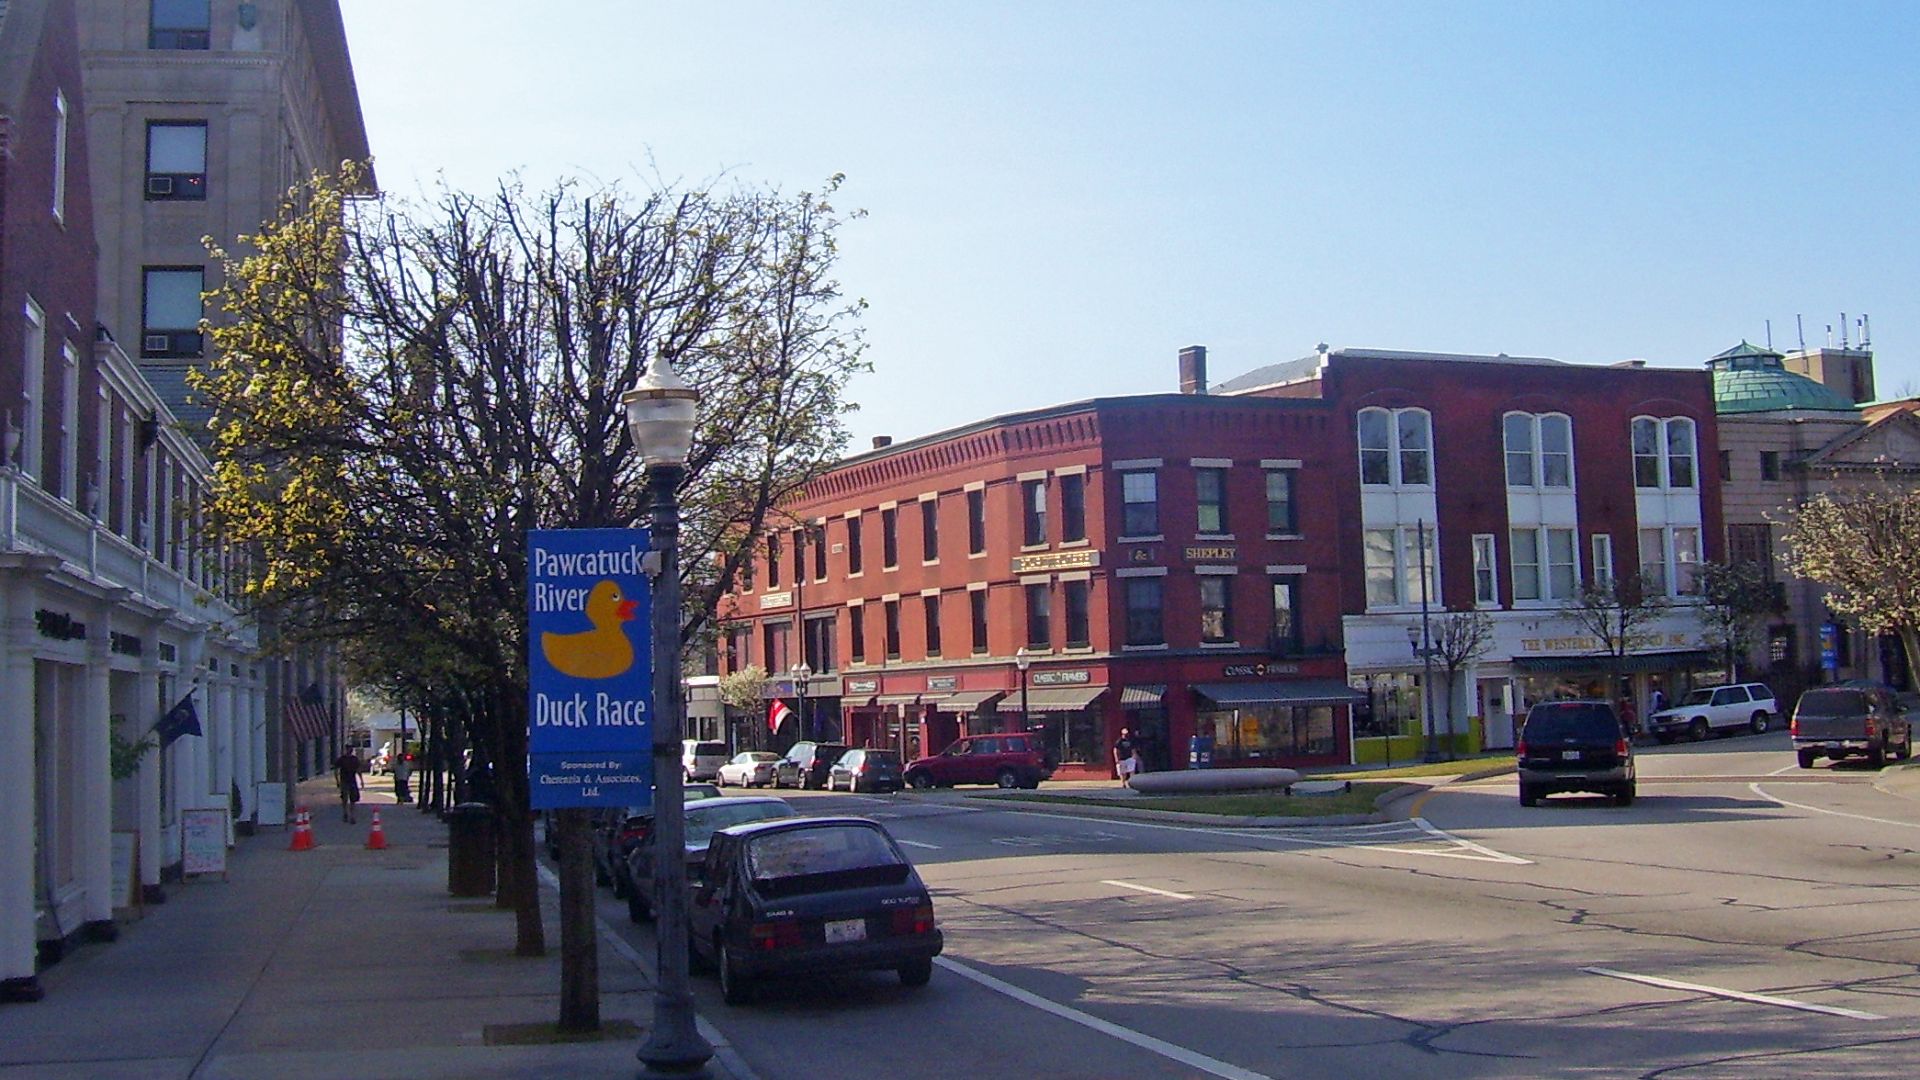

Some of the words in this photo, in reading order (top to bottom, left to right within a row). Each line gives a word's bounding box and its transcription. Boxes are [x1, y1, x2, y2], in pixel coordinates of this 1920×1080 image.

[535, 544, 644, 577] Pawcatuck
[1134, 550, 1147, 561] &
[1185, 547, 1235, 559] SHEPLEY
[535, 582, 589, 612] River
[536, 692, 589, 728] Duck
[596, 691, 646, 726] Race
[560, 761, 606, 770] Sponsored
[583, 774, 593, 784] &
